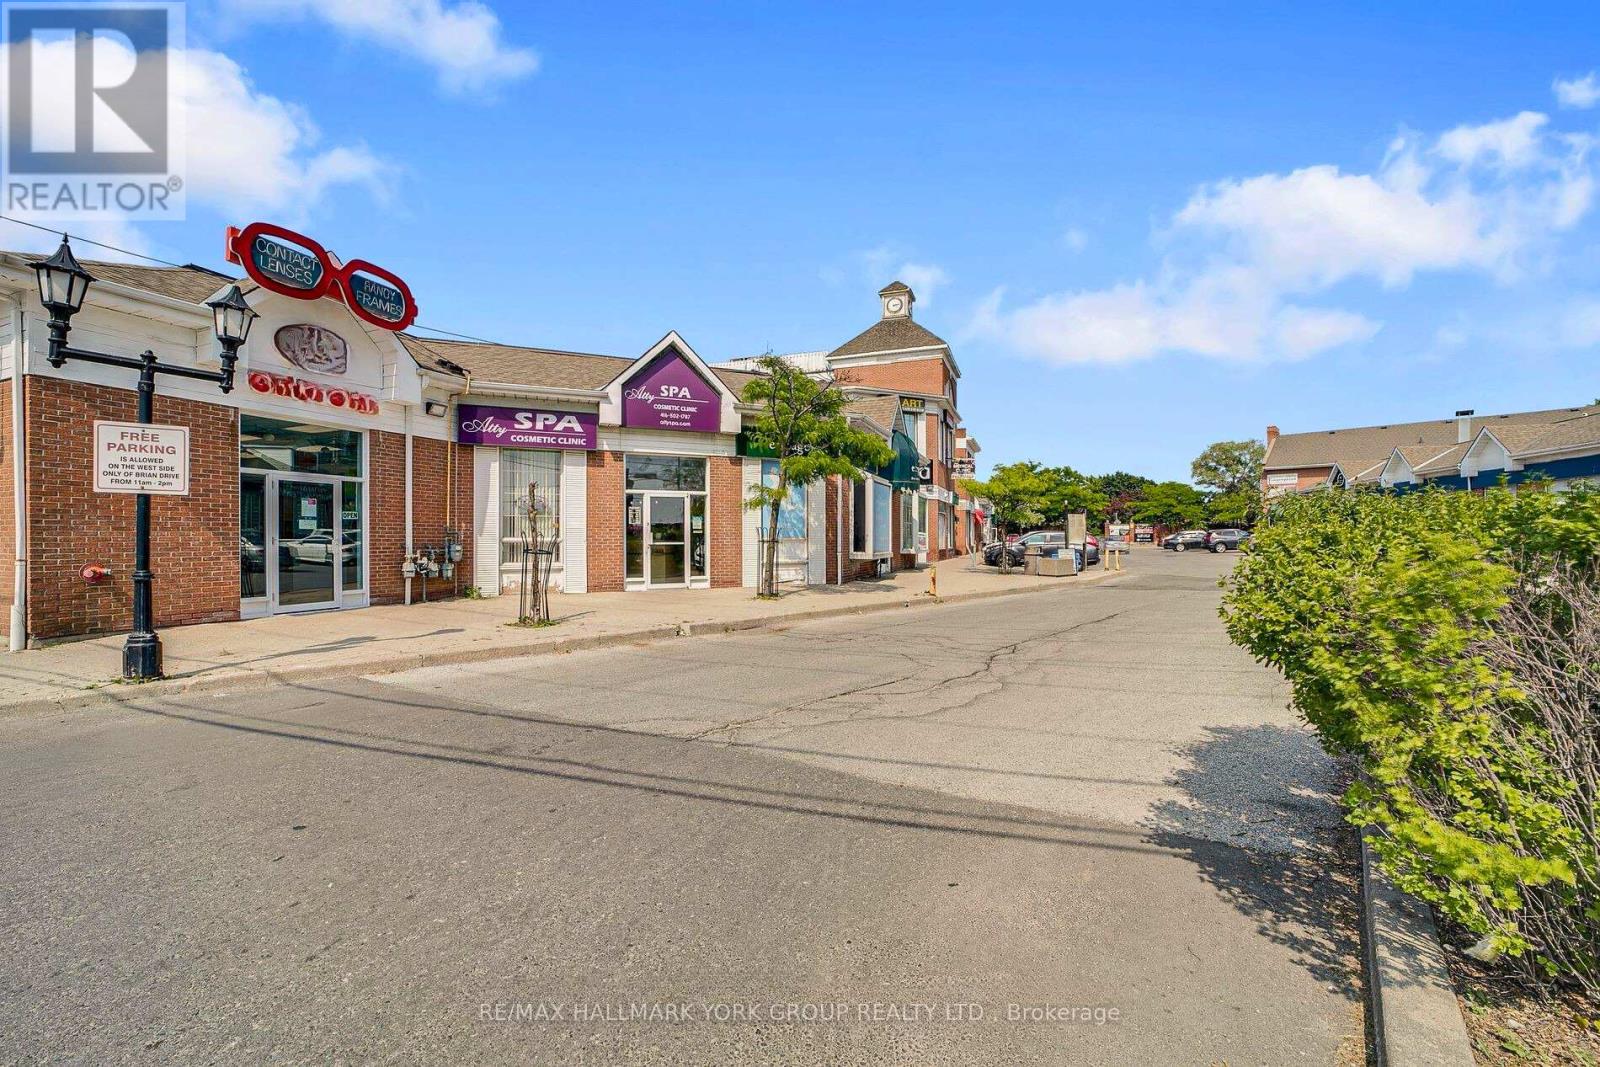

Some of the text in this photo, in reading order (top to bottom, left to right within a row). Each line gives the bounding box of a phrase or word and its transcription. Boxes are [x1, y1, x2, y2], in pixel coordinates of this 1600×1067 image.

[255, 238, 318, 271] CONTACT
[259, 255, 313, 285] LENSES
[356, 290, 403, 316] FRAMES
[624, 385, 692, 404] Atty SPA
[653, 403, 680, 411] COSMETIC
[462, 412, 584, 438] Atty SPA
[120, 431, 160, 443] FREE
[510, 435, 587, 446] COSMETIC CLINIC
[107, 442, 176, 455] PARKING
